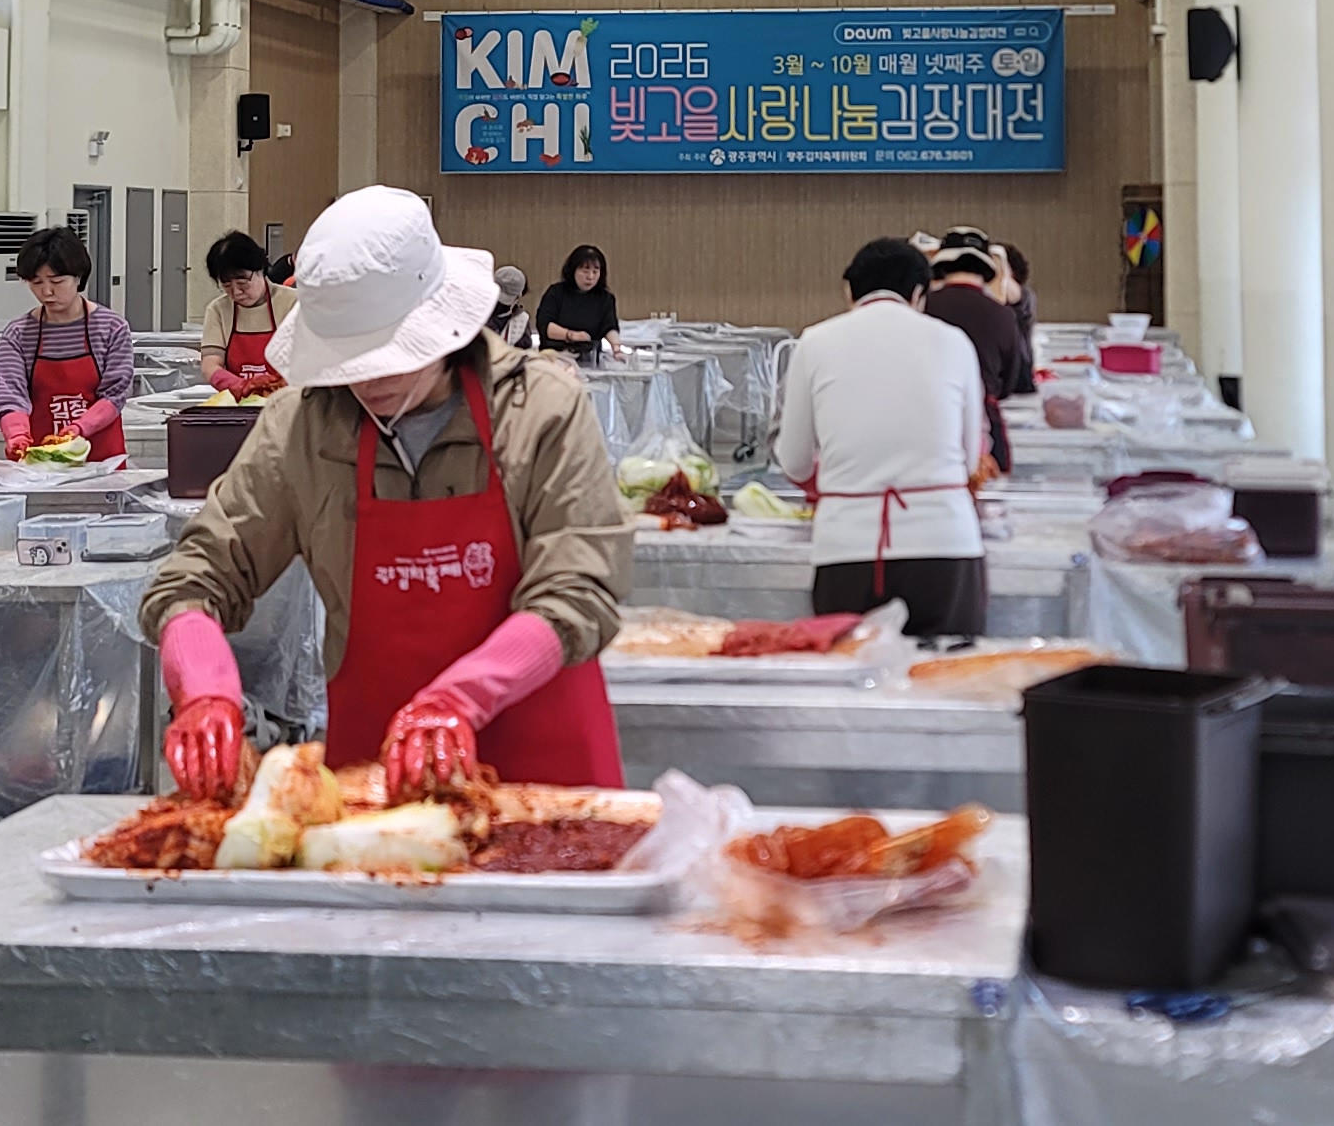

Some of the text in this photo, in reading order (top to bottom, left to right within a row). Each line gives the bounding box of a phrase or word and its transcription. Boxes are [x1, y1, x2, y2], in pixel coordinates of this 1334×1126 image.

[455, 29, 591, 89] KIM
[610, 43, 709, 79] 2026
[772, 54, 804, 76] 3월
[831, 53, 872, 75] 10월
[878, 52, 918, 75] 매월
[924, 52, 985, 75] 넷째주
[455, 103, 593, 164] CHI
[727, 150, 777, 163] 광주광역시
[49, 400, 89, 419] 김장
